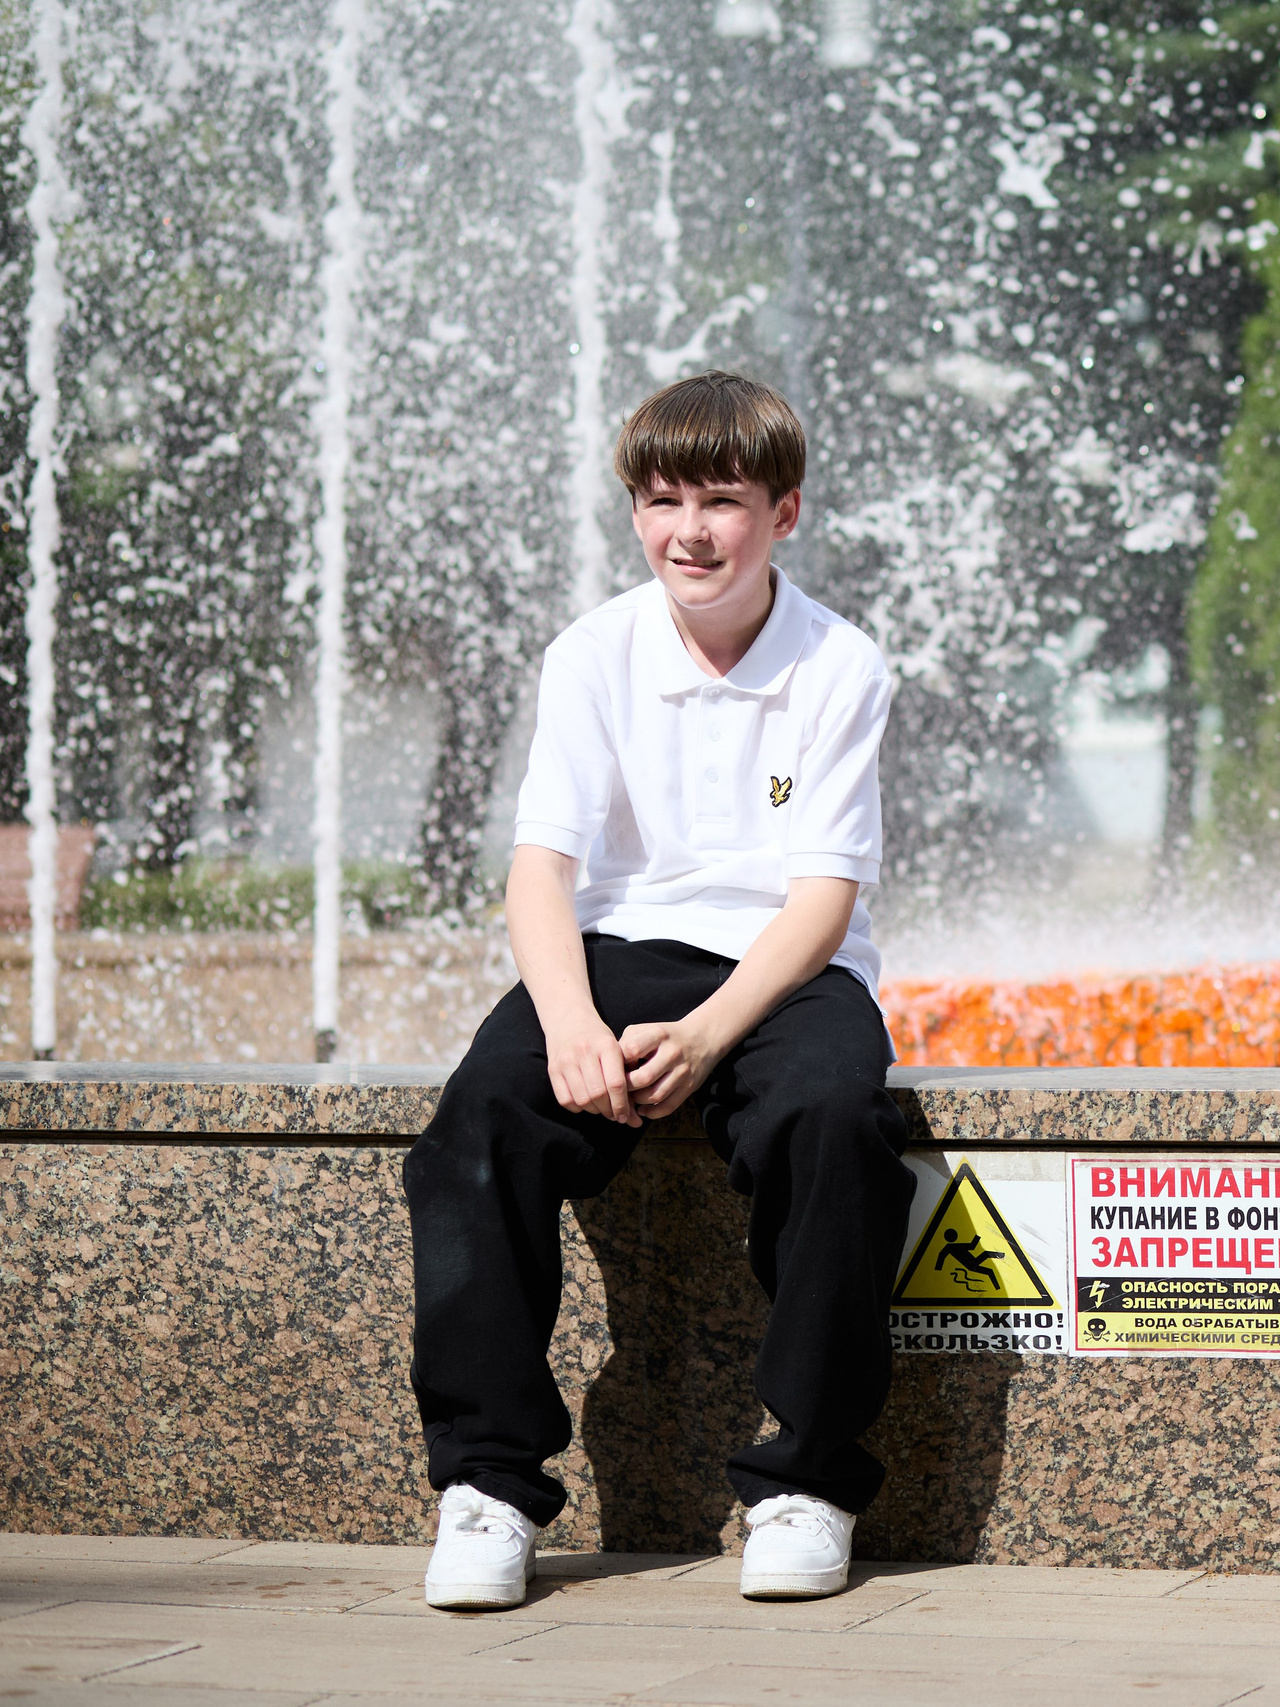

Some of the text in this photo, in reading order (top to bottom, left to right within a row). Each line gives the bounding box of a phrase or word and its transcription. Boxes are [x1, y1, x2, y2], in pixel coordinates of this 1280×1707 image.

[1091, 1206, 1198, 1230] КУПАНИЕ
[1205, 1207, 1220, 1231] В
[1121, 1281, 1228, 1294] ОПАСНОСТЬ
[1121, 1297, 1274, 1310] ЭЛЕКТРИЧЕСКИМ
[1134, 1317, 1178, 1330] ВОДА
[1114, 1332, 1236, 1345] ХИМИЧЕСКИМИ
